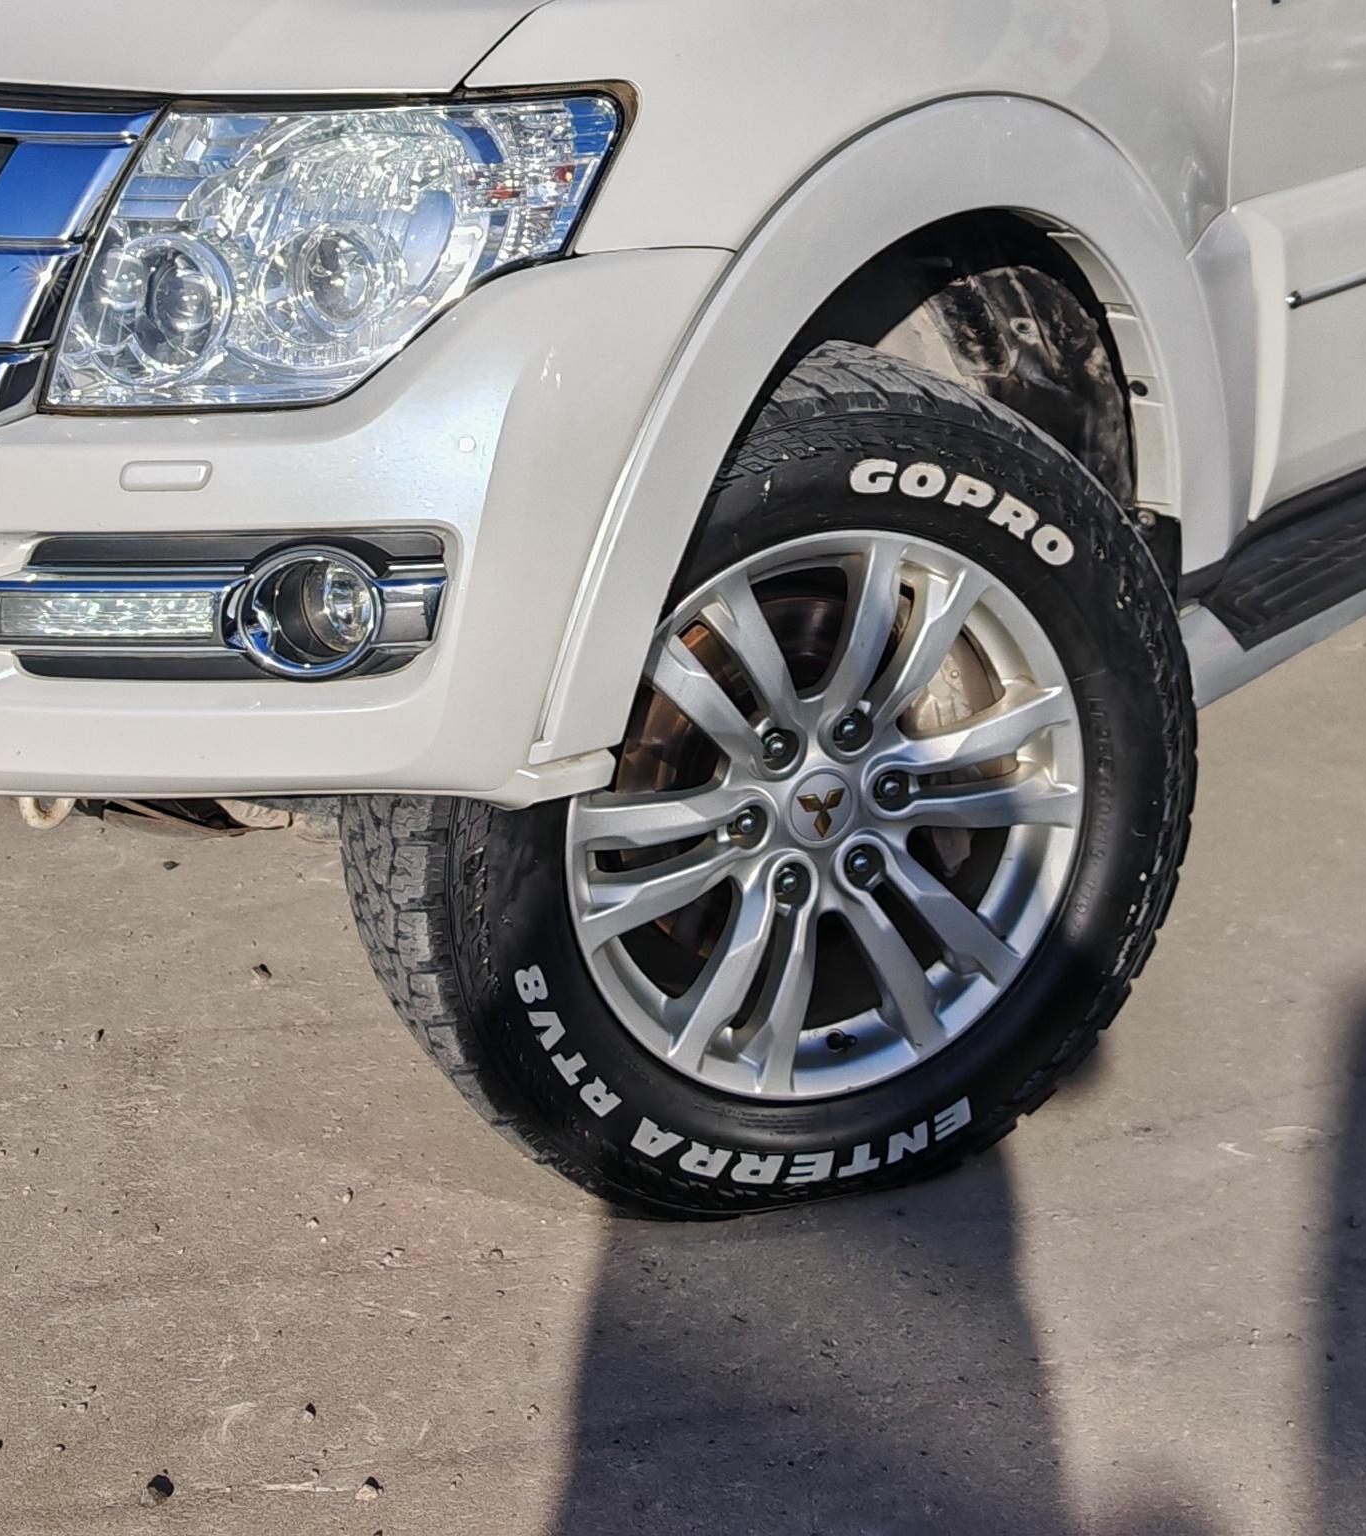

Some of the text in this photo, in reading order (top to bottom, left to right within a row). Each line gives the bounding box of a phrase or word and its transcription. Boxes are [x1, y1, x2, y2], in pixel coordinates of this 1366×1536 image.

[849, 457, 1076, 567] GOPRO
[513, 963, 973, 1186] ENTERRA RTV8
